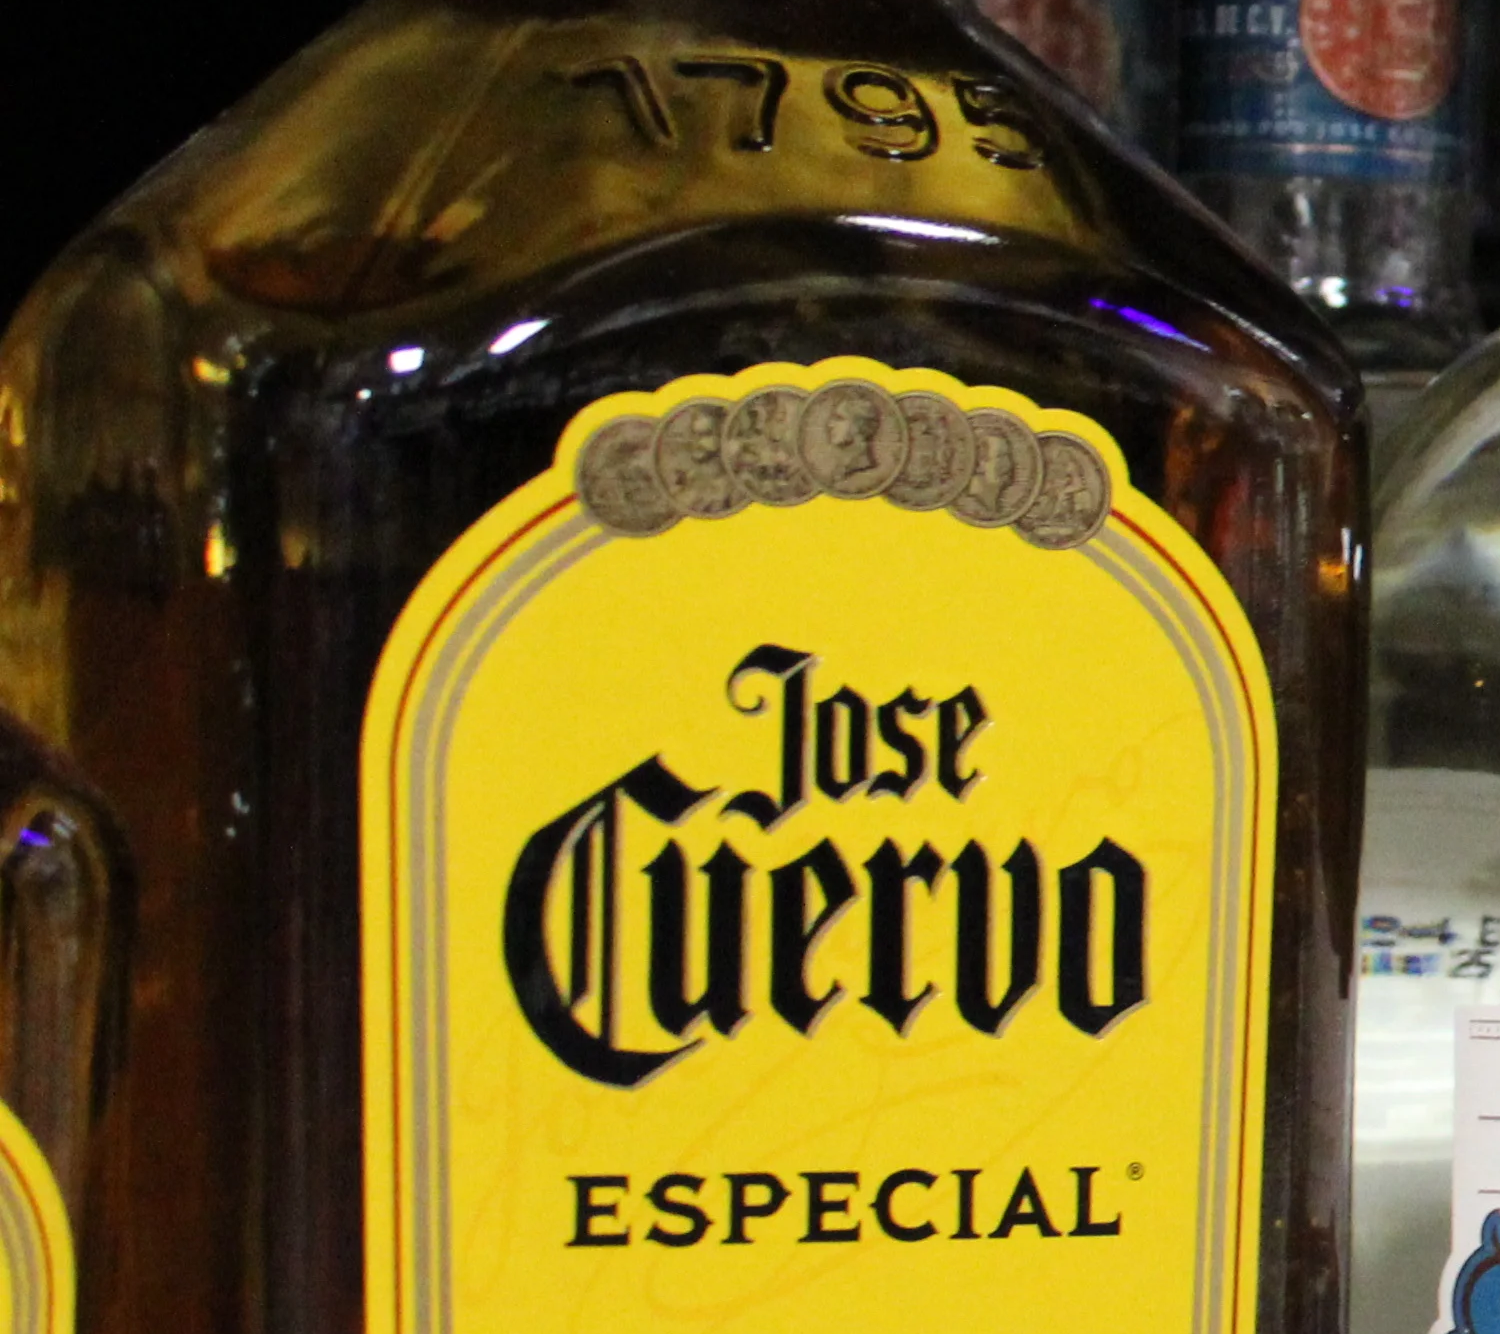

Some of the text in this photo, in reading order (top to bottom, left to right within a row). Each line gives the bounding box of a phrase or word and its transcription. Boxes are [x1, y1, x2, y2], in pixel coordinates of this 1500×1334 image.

[568, 53, 1046, 171] 1795
[725, 641, 990, 834] Jose
[500, 751, 1150, 1093] Cuervo
[562, 1164, 1124, 1250] ESPECIAL
